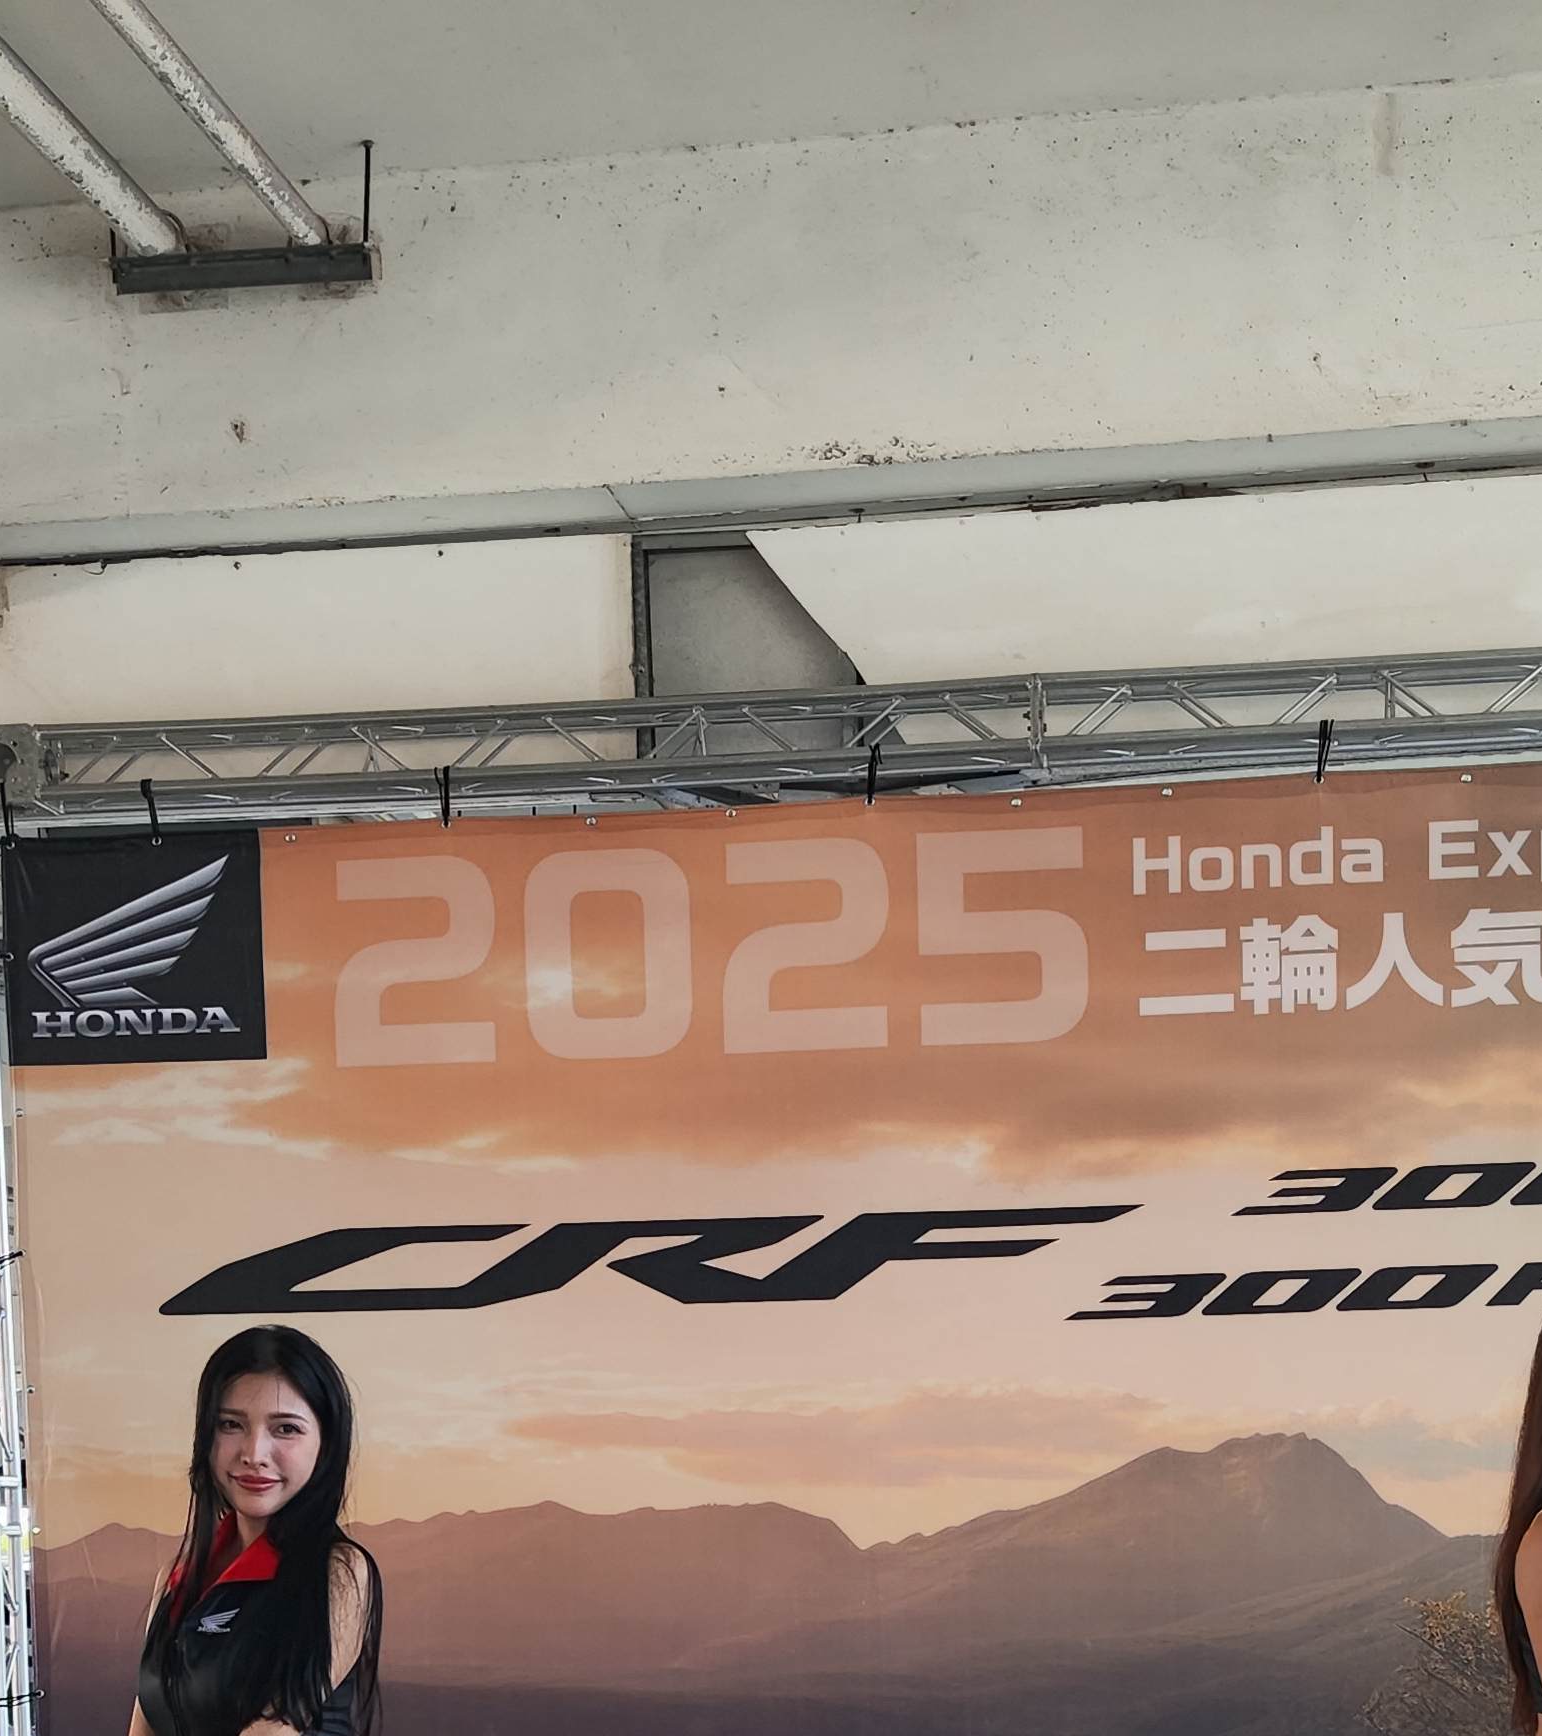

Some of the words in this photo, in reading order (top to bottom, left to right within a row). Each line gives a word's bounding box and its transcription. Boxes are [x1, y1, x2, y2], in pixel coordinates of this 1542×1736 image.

[1131, 826, 1385, 895] Honda
[333, 827, 1090, 1068] 2025
[30, 1004, 242, 1039] HONDA
[159, 1203, 1145, 1316] CRF
